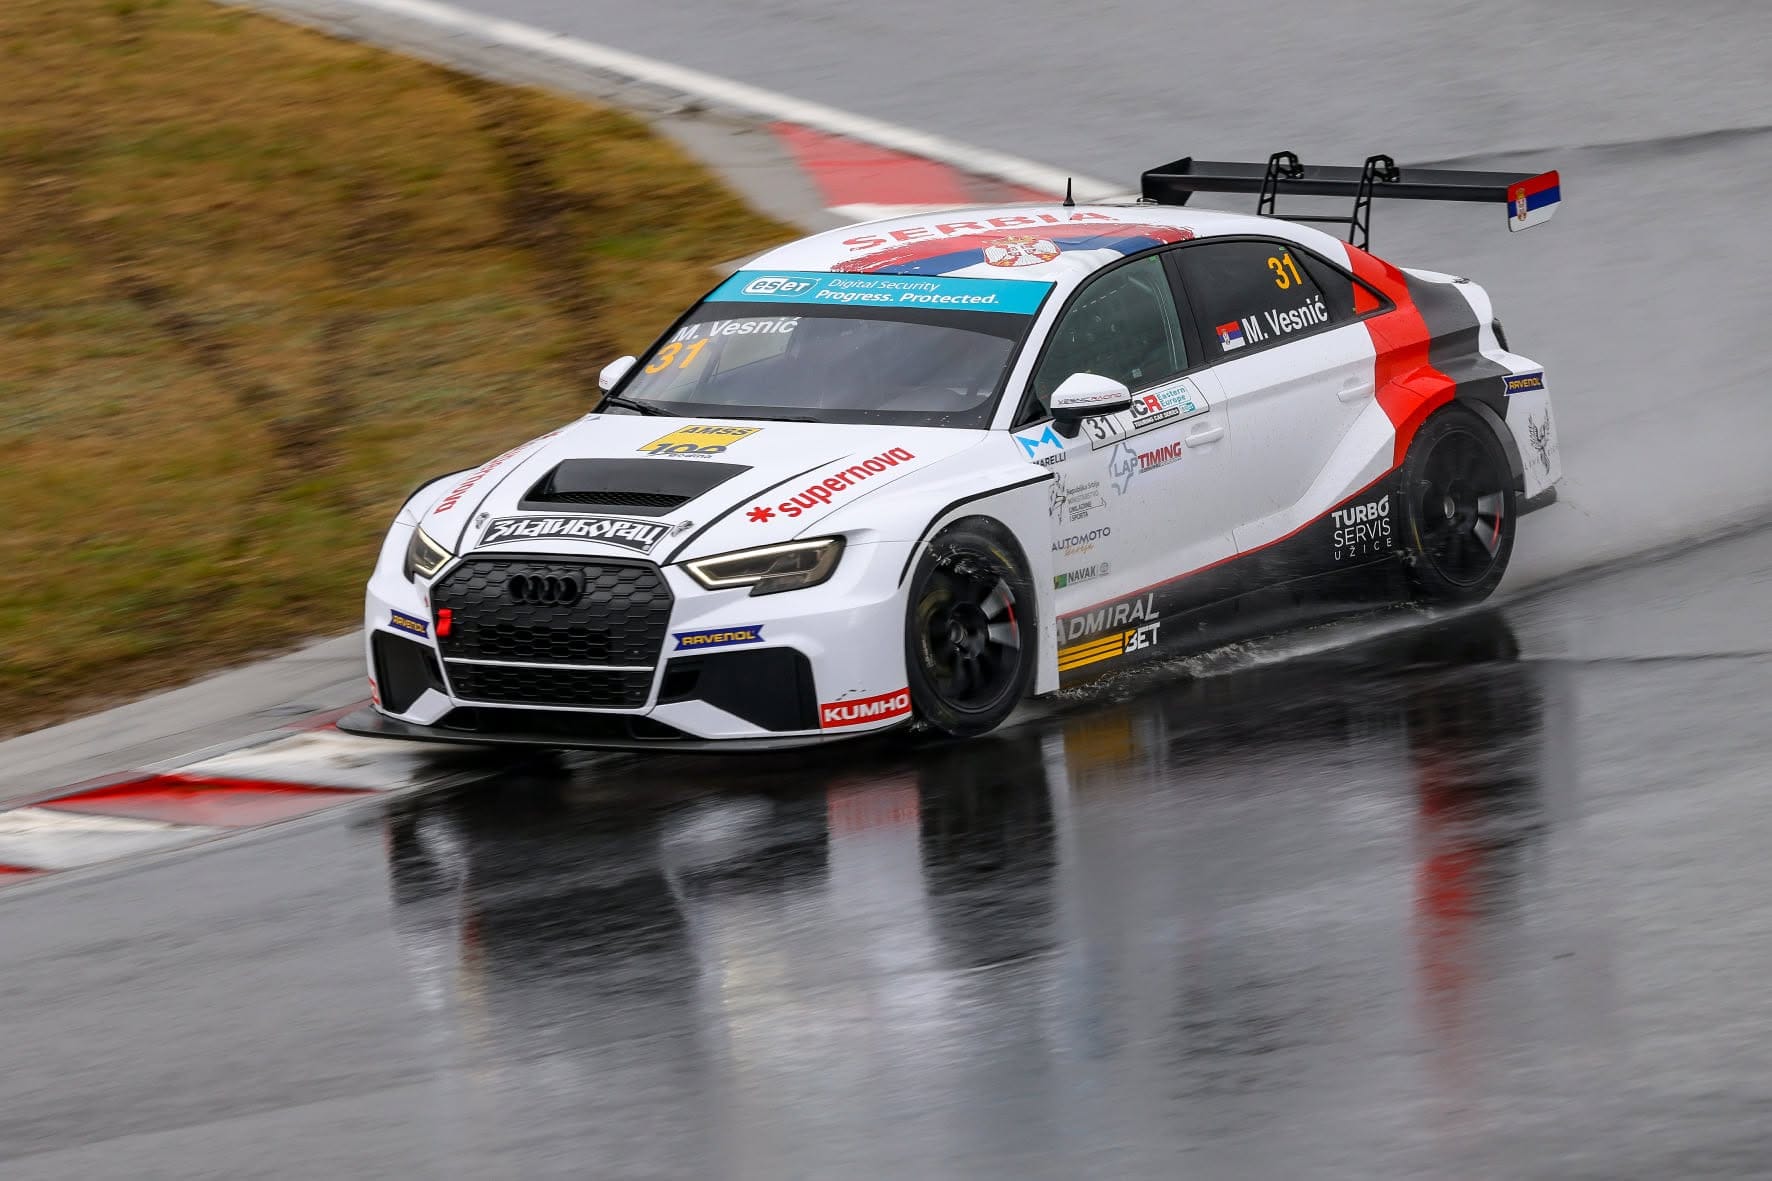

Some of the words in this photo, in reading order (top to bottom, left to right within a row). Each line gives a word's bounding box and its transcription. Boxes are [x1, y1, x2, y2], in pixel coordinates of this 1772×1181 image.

[841, 211, 1120, 252] SERBIA
[1267, 252, 1303, 290] 31
[815, 289, 894, 302] Progress.
[899, 292, 999, 305] Protected.
[828, 278, 874, 290] Digital
[877, 280, 941, 292] Security
[672, 326, 699, 343] M.
[709, 316, 802, 338] Vesnić
[1241, 316, 1268, 345] M.
[1267, 295, 1329, 338] Vesnić
[645, 338, 712, 376] 31
[1508, 377, 1541, 390] RAVENOL
[1160, 394, 1186, 408] Europe
[680, 426, 752, 435] AMSS
[1087, 416, 1117, 439] 31
[647, 443, 728, 455] 100
[778, 447, 916, 518] supernova
[1331, 494, 1390, 528] TURBO
[1051, 526, 1111, 553] AUTOMOTO
[1334, 518, 1391, 548] SERVIS
[1334, 538, 1392, 560] UŽICE
[1067, 565, 1096, 583] NAVAK
[682, 630, 756, 646] RAVENOL
[1124, 621, 1161, 653] BET
[823, 693, 910, 723] KUMHO
